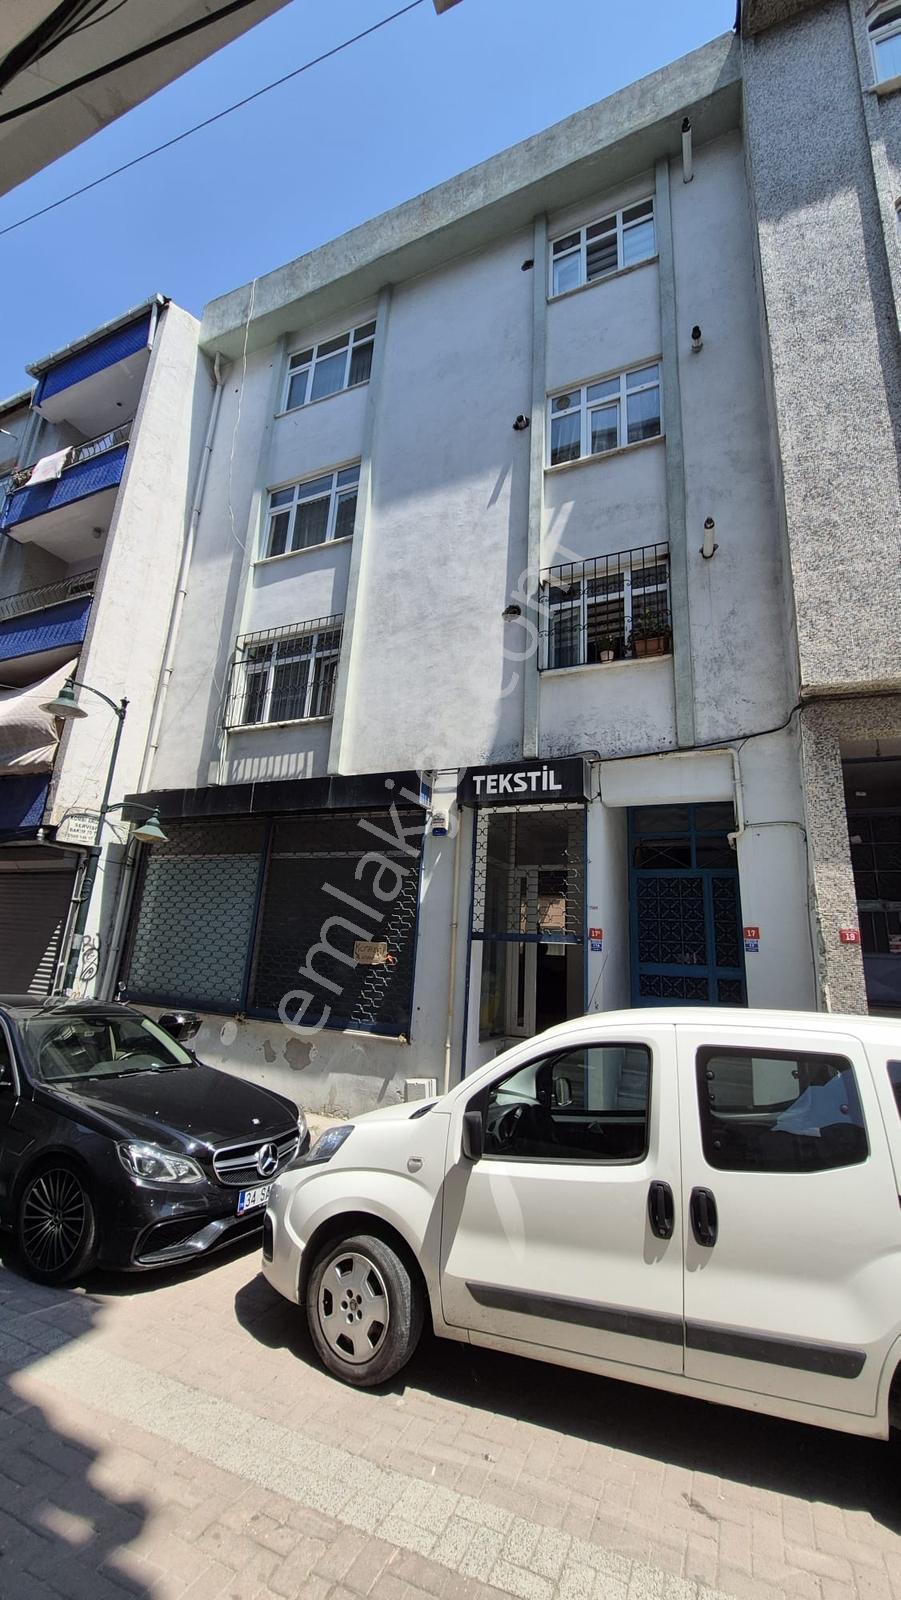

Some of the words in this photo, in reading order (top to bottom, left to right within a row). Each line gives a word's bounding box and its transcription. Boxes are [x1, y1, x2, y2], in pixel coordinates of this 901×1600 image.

[472, 765, 563, 795] TEKSTİL
[746, 929, 756, 937] 17
[245, 1191, 256, 1207] 34
